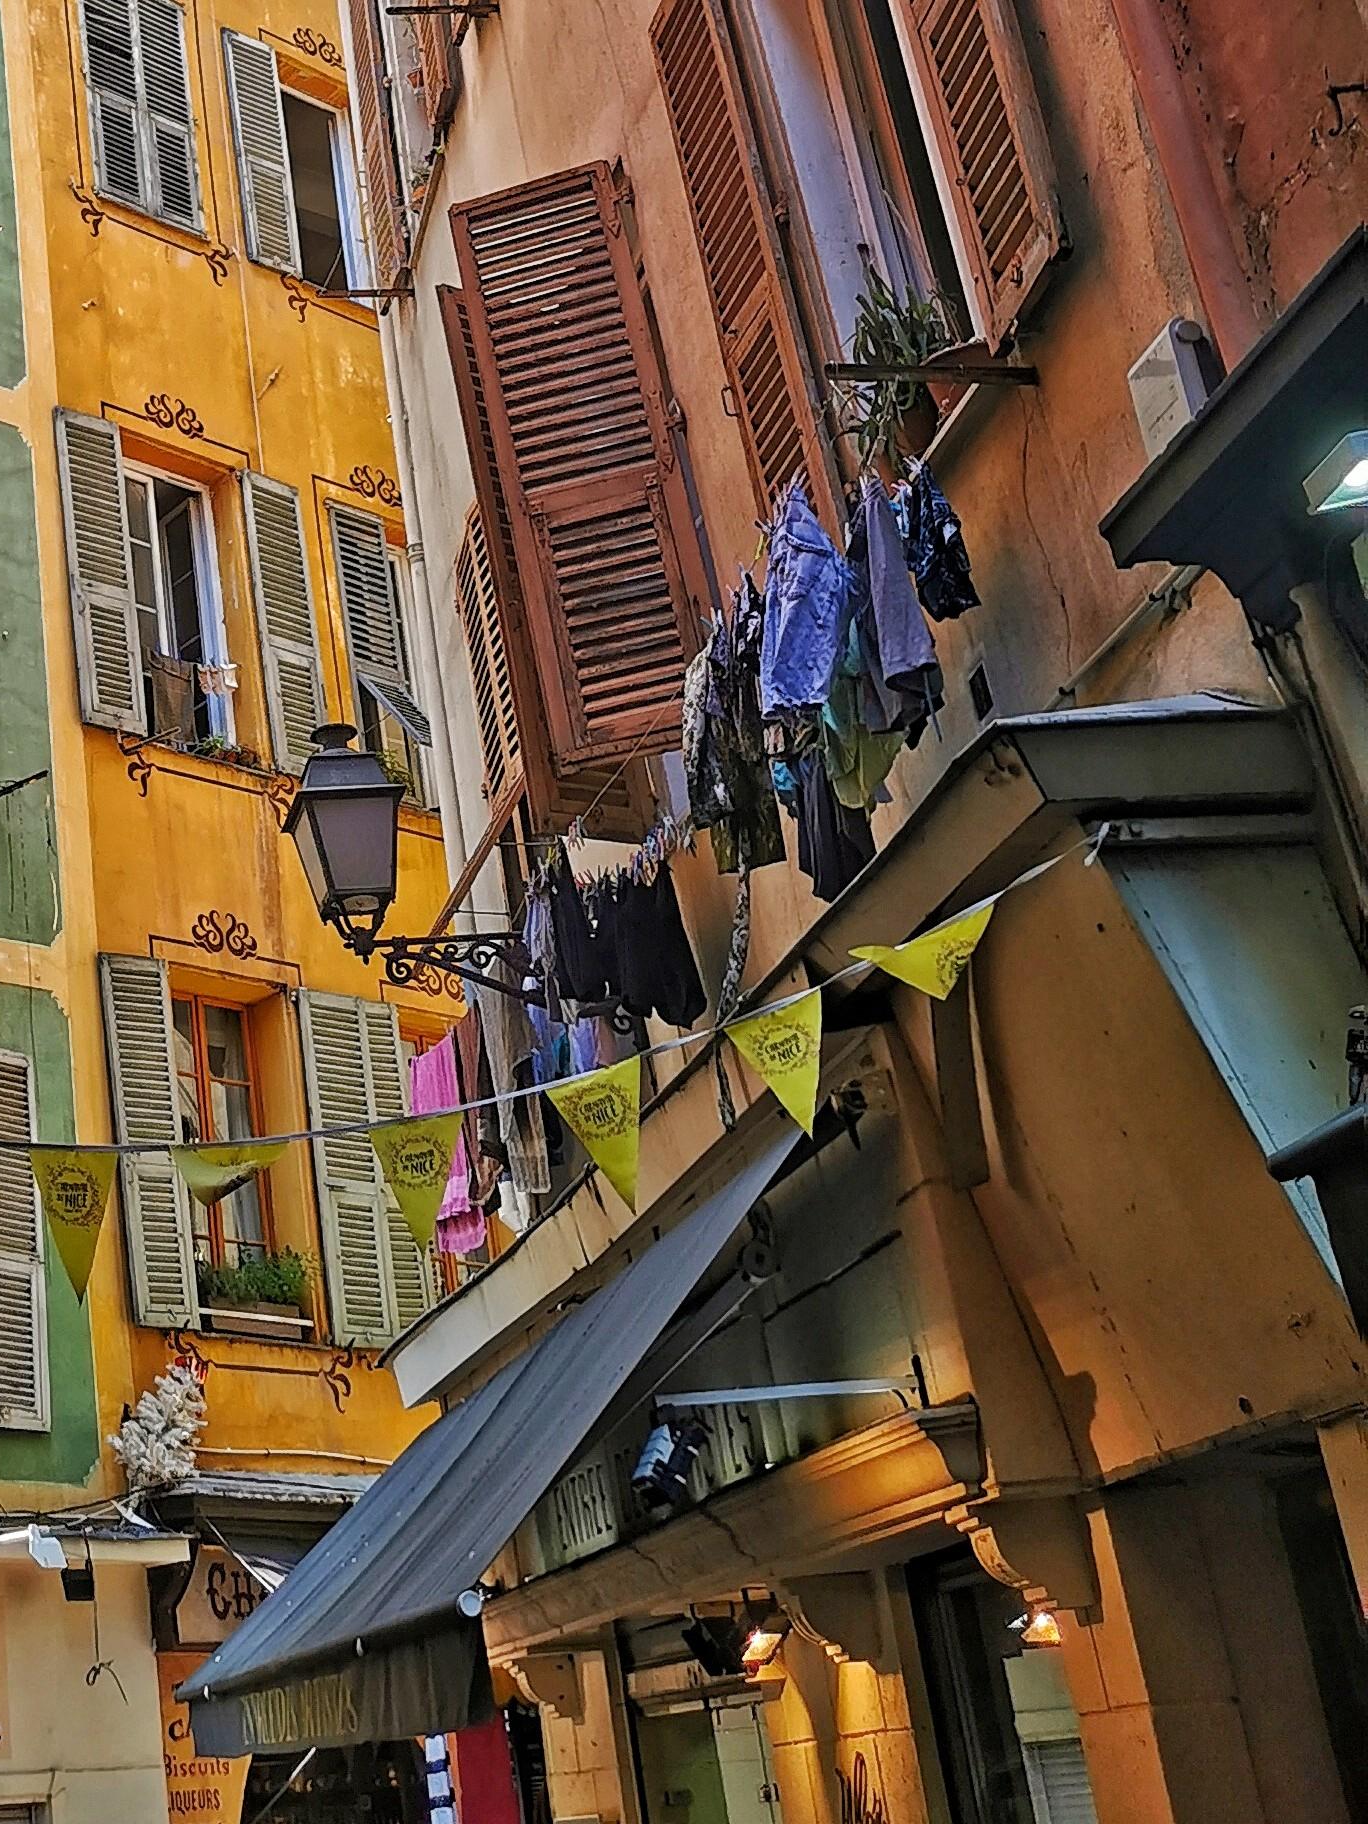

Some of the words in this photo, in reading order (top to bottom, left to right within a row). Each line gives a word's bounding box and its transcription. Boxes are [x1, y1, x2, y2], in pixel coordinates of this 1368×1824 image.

[777, 1041, 802, 1062] NICE
[592, 1102, 620, 1125] NICE
[410, 1158, 436, 1176] NICE
